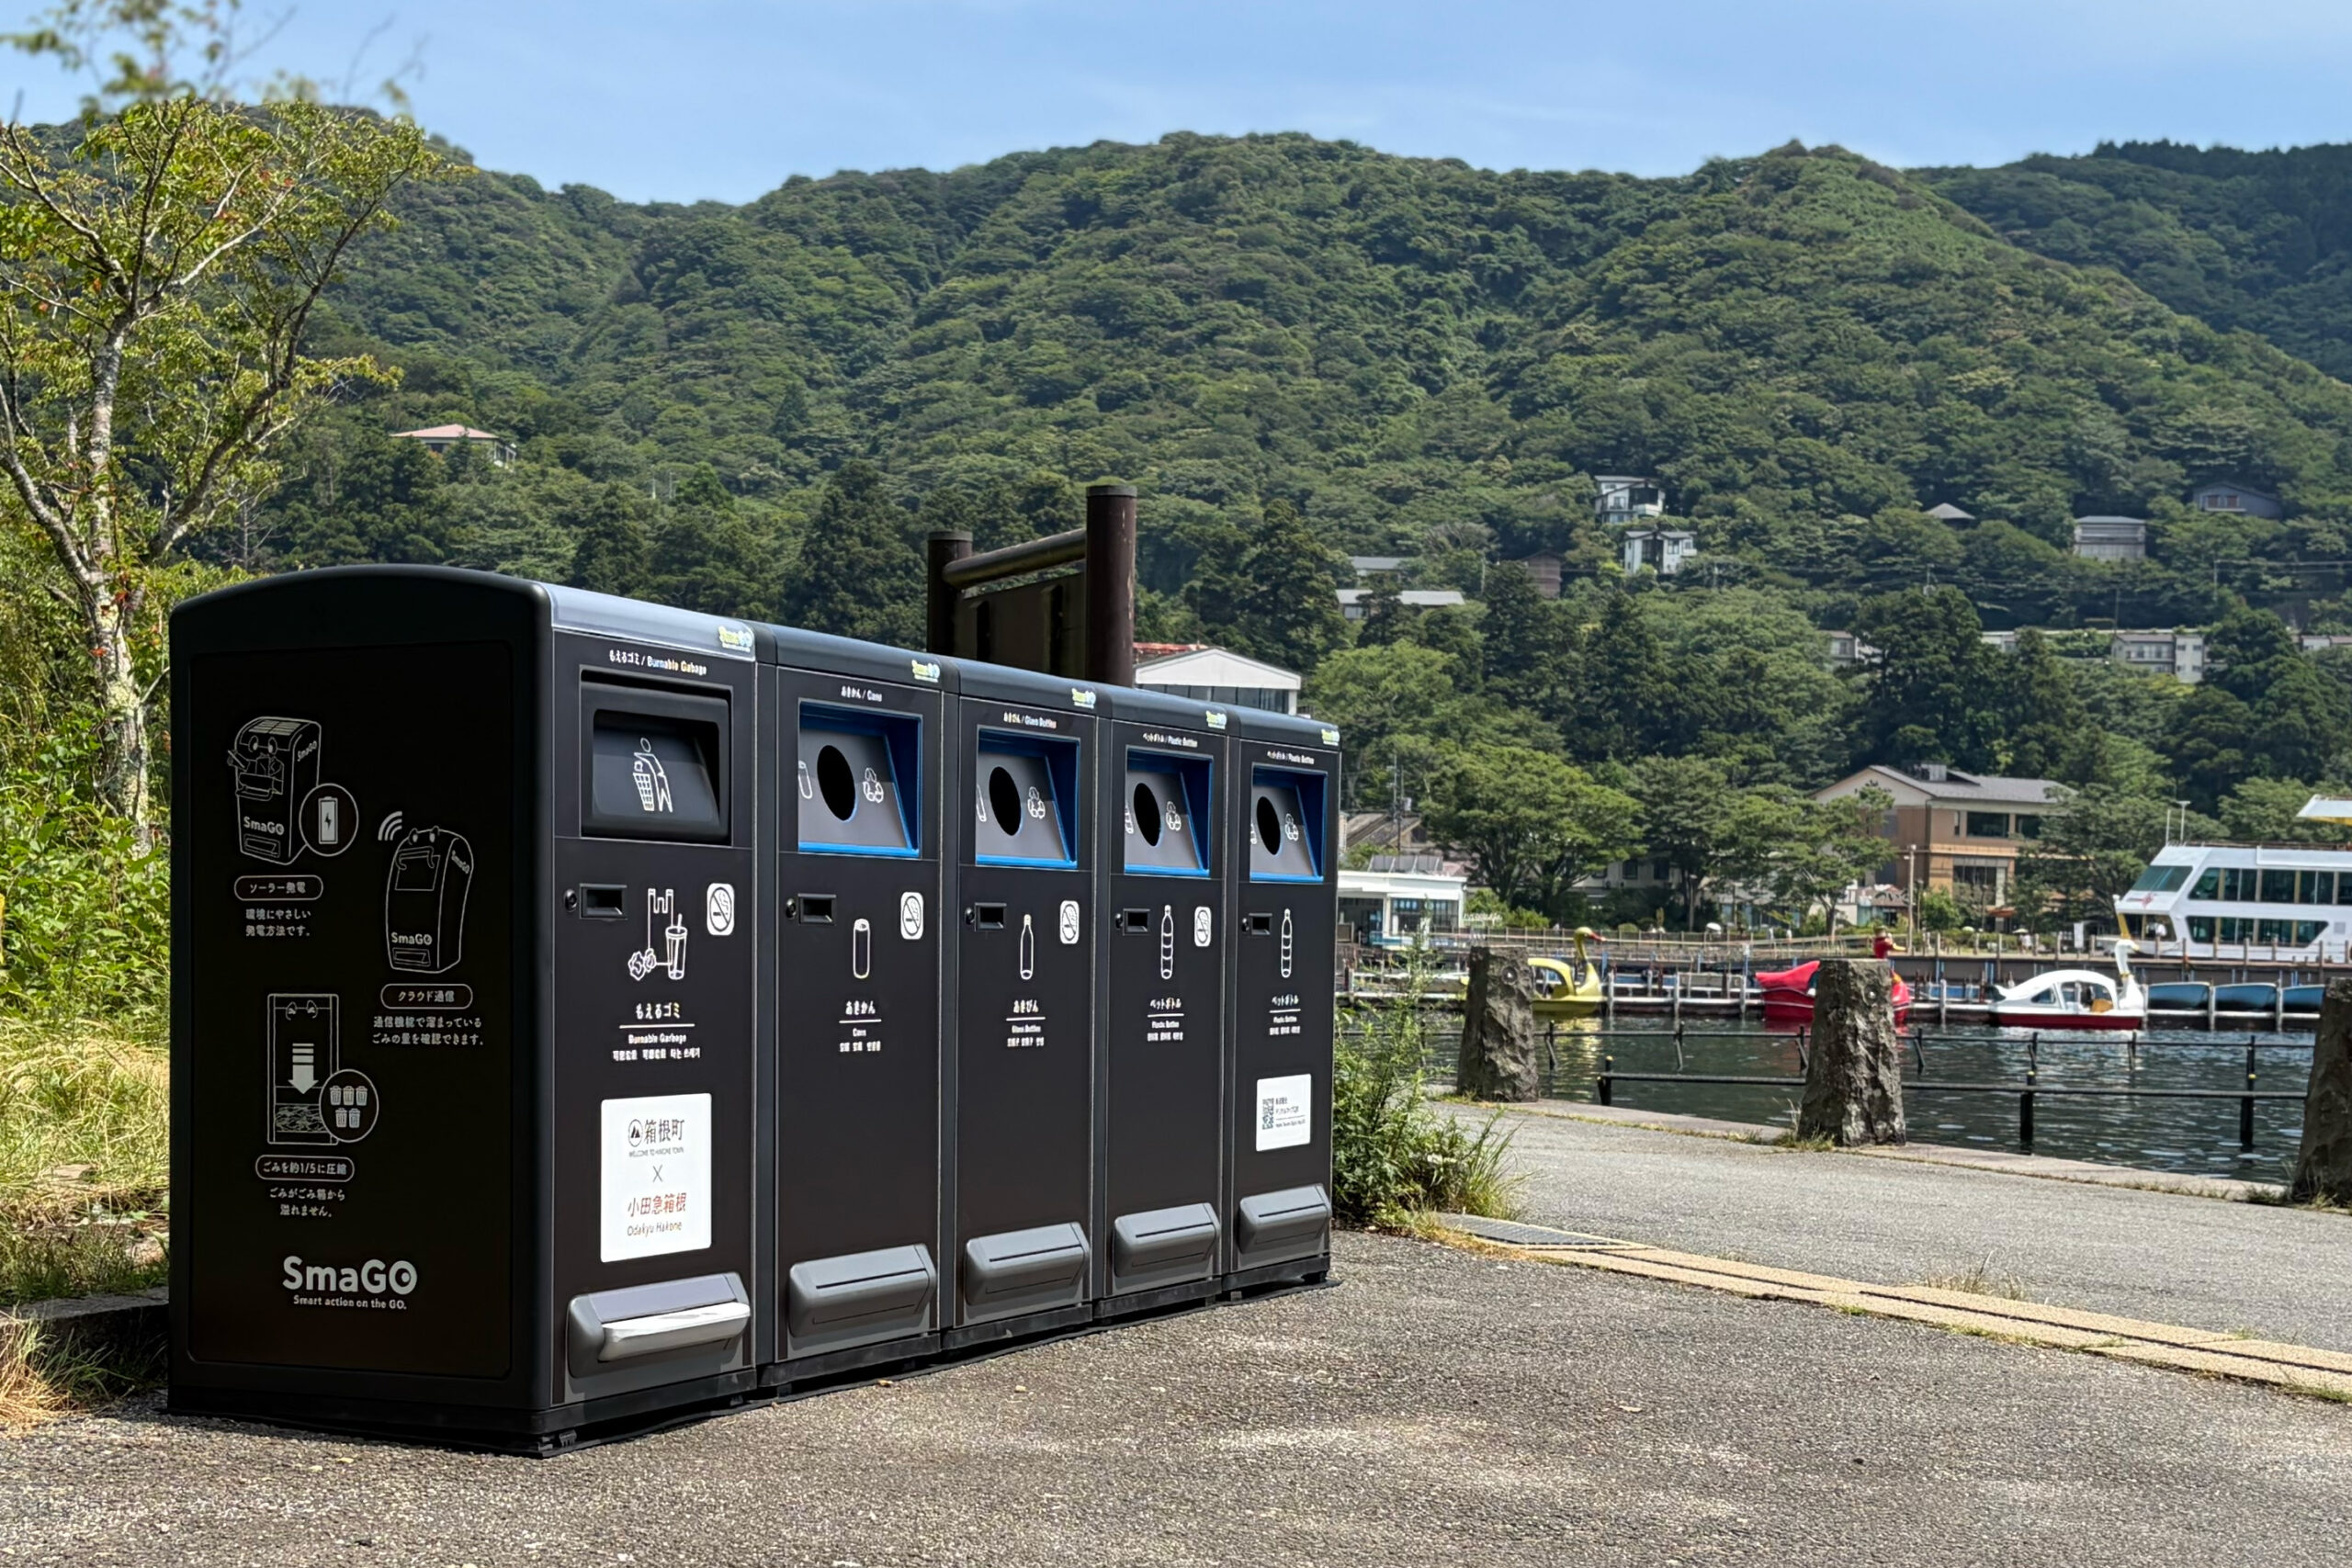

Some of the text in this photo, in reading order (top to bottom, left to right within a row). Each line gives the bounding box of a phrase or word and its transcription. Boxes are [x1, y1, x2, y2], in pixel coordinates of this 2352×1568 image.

[609, 649, 640, 665] もえるゴミ
[647, 655, 679, 671] Burnable
[243, 816, 285, 835] SmaGO
[250, 882, 306, 894] ソーラー発電
[245, 908, 311, 919] 環境にやさしい
[245, 924, 311, 937] 発電方法です。
[390, 931, 433, 945] SmaGO
[398, 990, 455, 1002] クラウド通信
[636, 1002, 681, 1020] もえるゴミ
[659, 1032, 687, 1044] Garbage
[644, 1118, 685, 1145] 箱根町
[269, 1187, 345, 1201] ごみがごみ箱から
[628, 1192, 687, 1217] 小田急箱根
[627, 1221, 683, 1237] Odakyu Hakone
[282, 1256, 418, 1295] SmaGO
[293, 1294, 407, 1310] Smart action on the GO.
